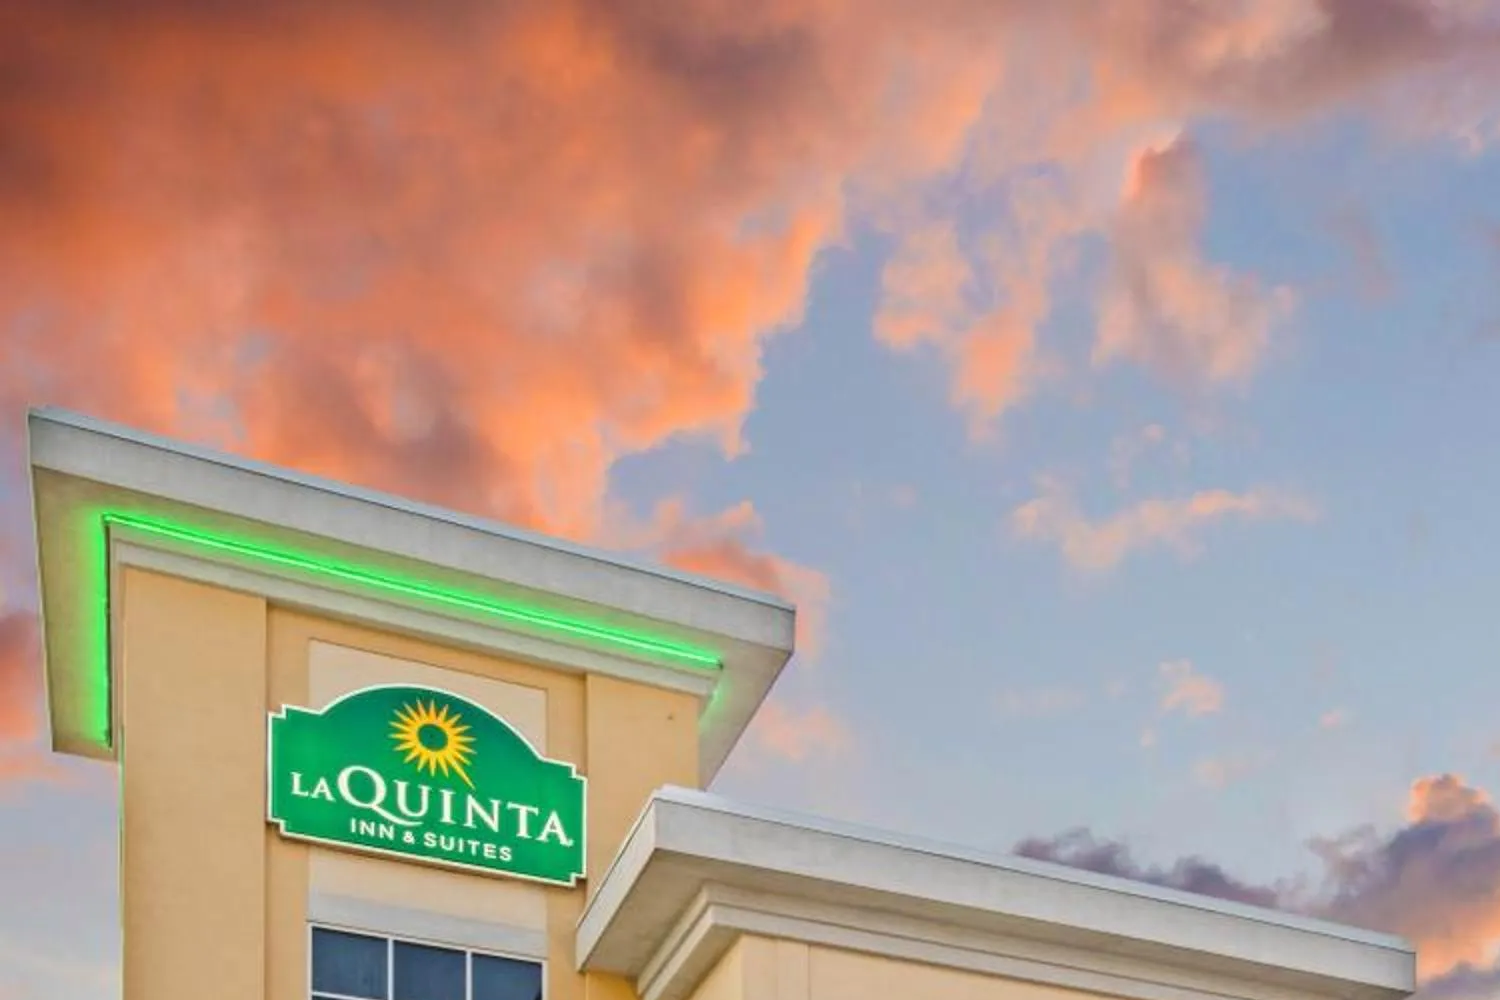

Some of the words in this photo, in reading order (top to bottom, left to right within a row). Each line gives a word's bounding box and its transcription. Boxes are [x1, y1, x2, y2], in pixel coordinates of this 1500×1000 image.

[350, 817, 394, 840] INN
[403, 831, 416, 844] &
[423, 832, 513, 862] SUITES
